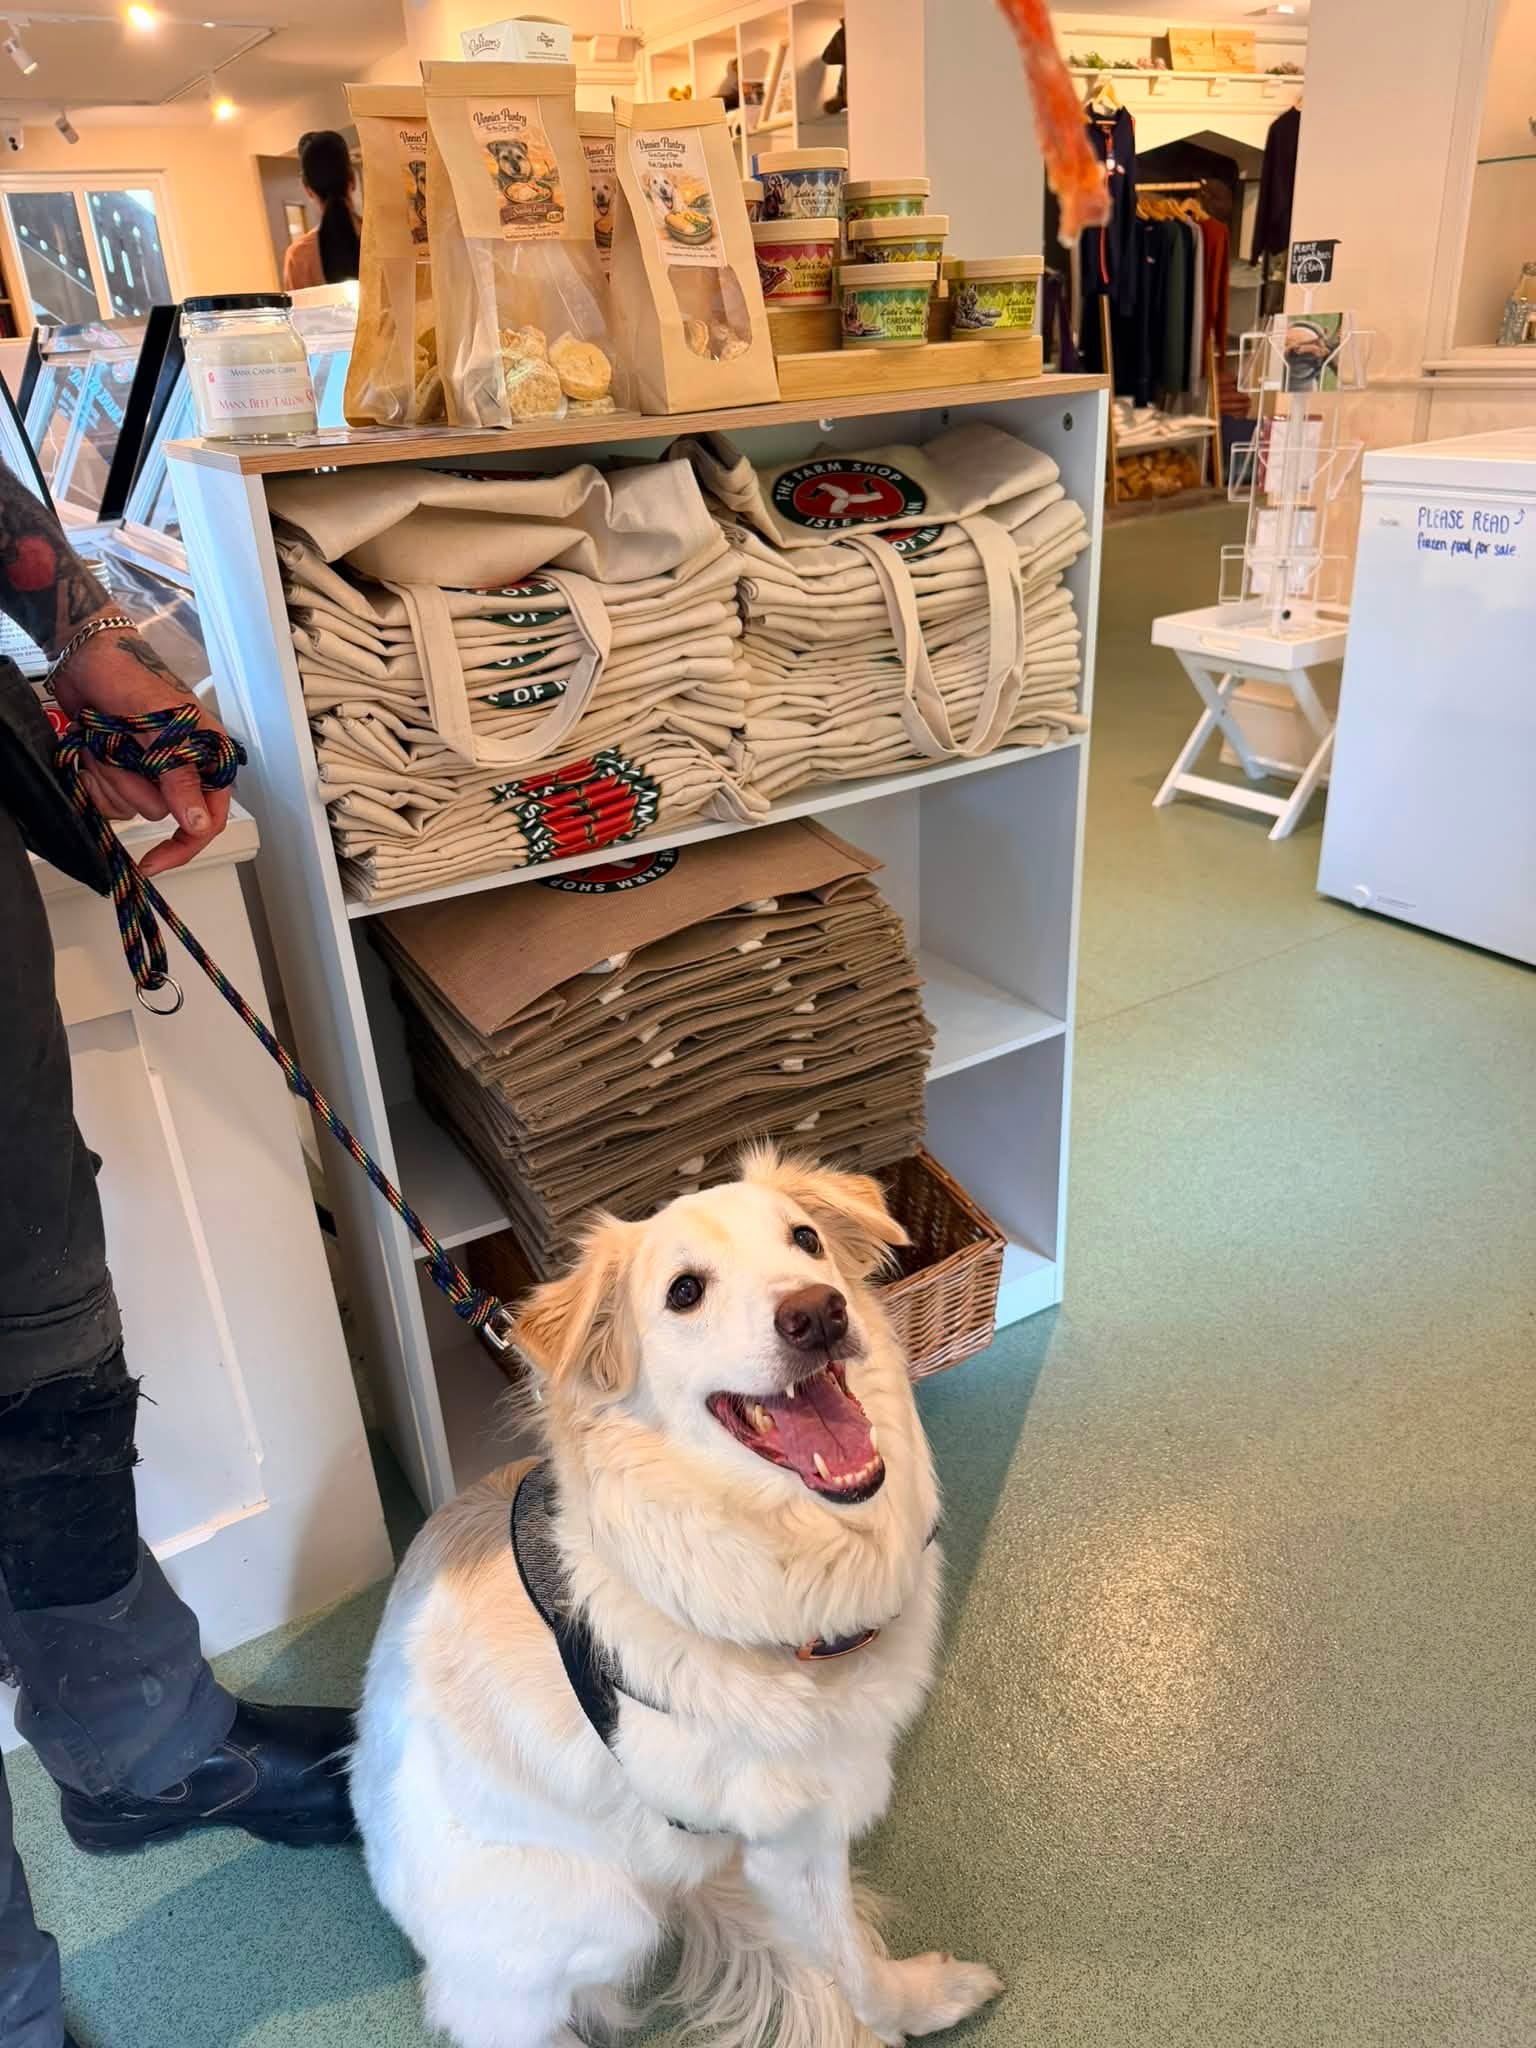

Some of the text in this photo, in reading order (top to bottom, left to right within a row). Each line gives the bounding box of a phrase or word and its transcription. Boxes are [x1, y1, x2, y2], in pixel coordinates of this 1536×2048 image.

[473, 107, 527, 127] Vinnies Pantry
[660, 136, 686, 153] Pantry
[218, 399, 248, 409] MANX
[775, 462, 903, 501] THE FARM SHOP
[804, 516, 852, 529] ISLE
[1417, 506, 1465, 530] PLEASE
[1471, 510, 1510, 534] READ
[891, 538, 917, 551] OF
[1416, 531, 1447, 551] frozen
[1474, 540, 1490, 559] for
[1493, 543, 1517, 557] sale
[512, 684, 545, 703] OF
[548, 878, 607, 893] SHOP
[615, 865, 667, 890] FARM
